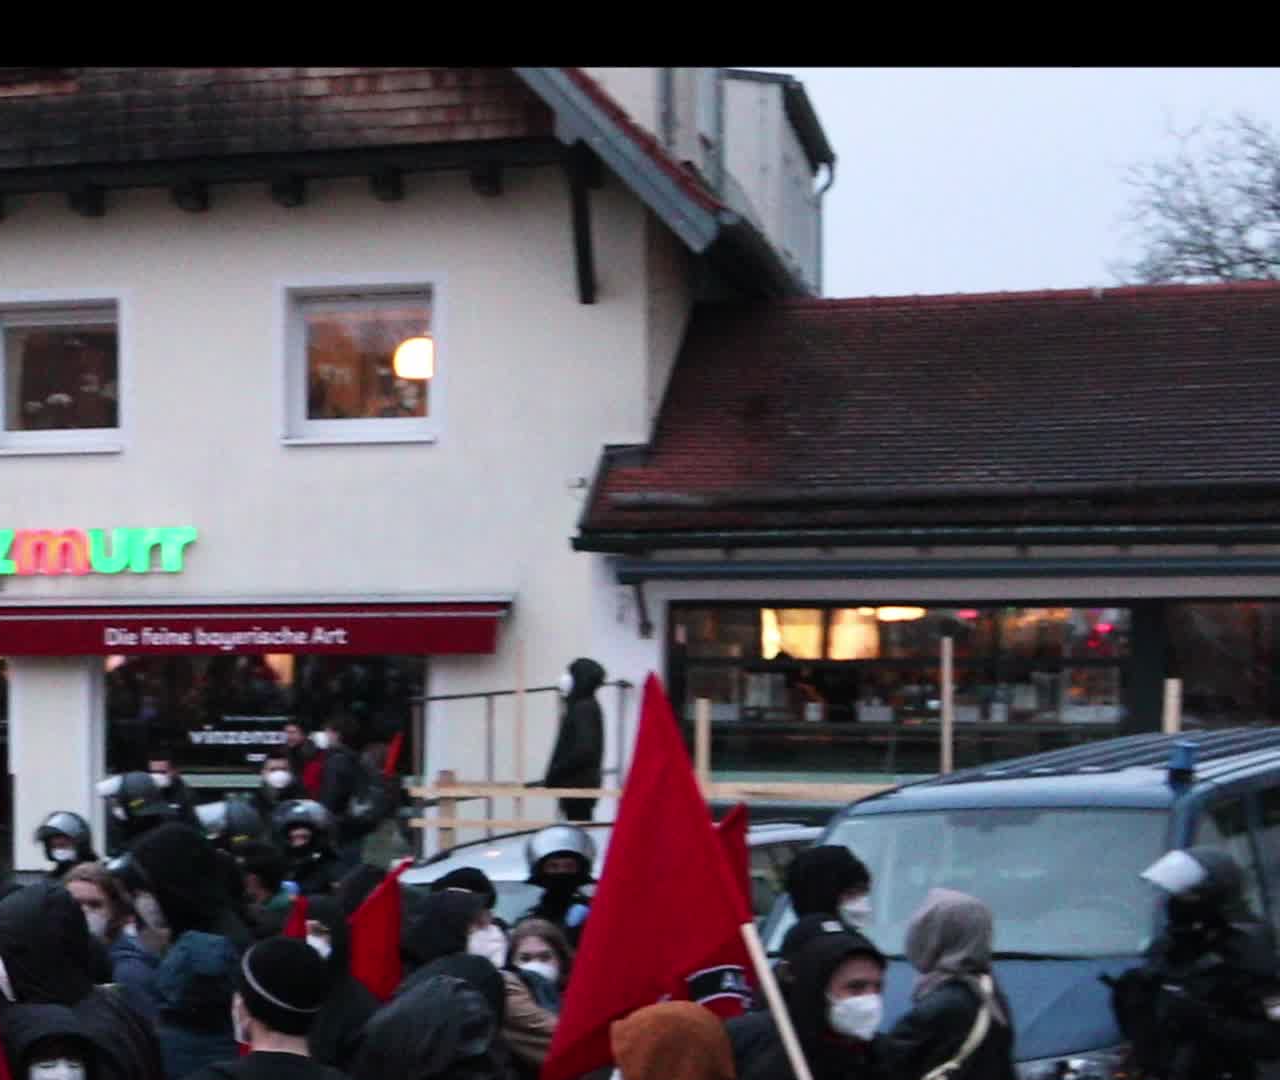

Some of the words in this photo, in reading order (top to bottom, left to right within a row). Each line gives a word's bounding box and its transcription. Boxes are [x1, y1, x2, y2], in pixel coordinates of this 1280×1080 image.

[104, 627, 138, 646] Die
[141, 626, 192, 646] feine
[195, 626, 308, 651] bayerische
[311, 626, 348, 645] Art
